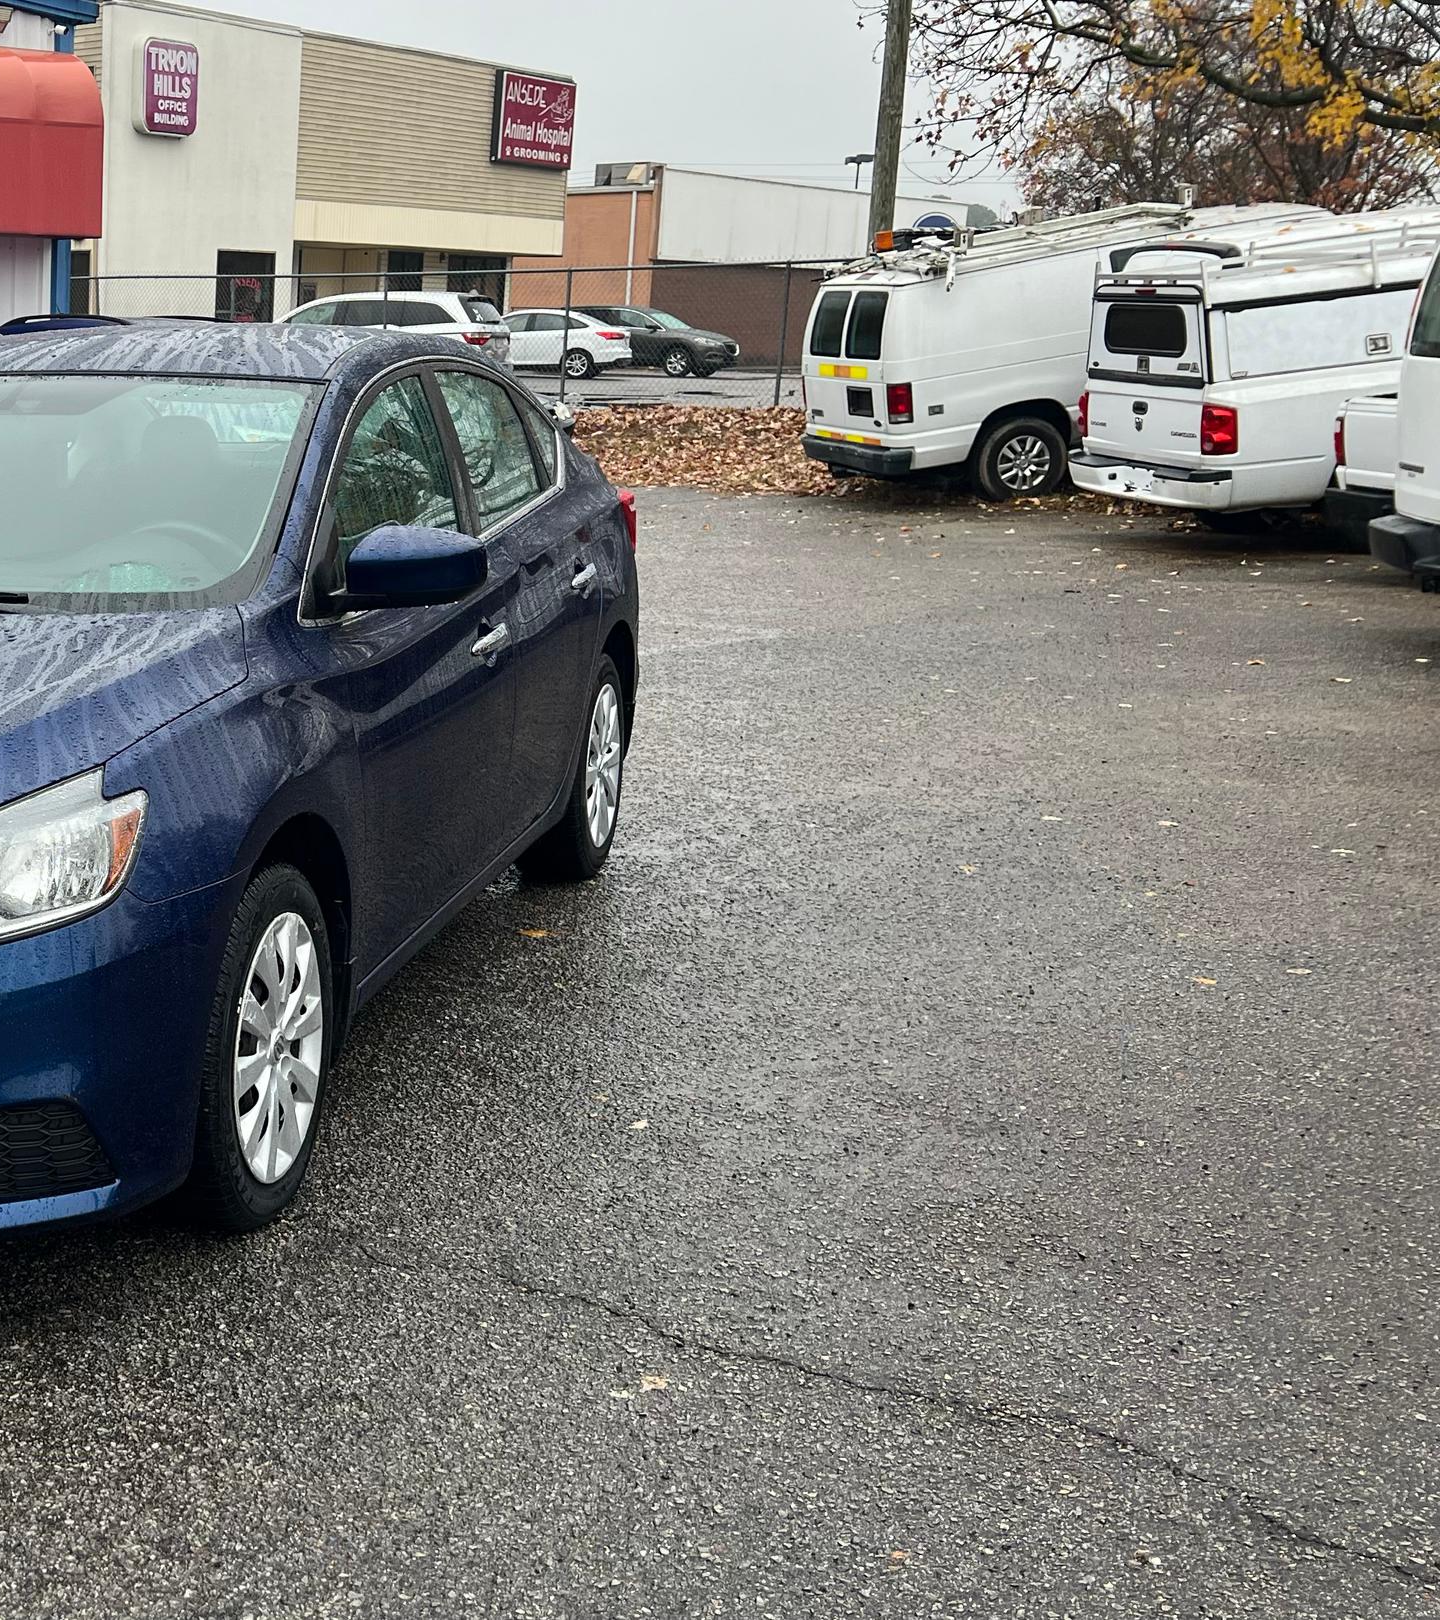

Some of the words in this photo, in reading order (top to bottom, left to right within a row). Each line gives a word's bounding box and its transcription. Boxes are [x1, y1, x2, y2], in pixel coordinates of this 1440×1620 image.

[148, 46, 197, 75] TRYON
[153, 73, 191, 99] HILLS
[506, 79, 547, 108] ANSEDE
[158, 98, 187, 112] OFFICE
[153, 112, 189, 126] BUILDING
[504, 117, 536, 142] Animal
[535, 120, 572, 150] Hospital
[513, 147, 561, 163] GROOMING
